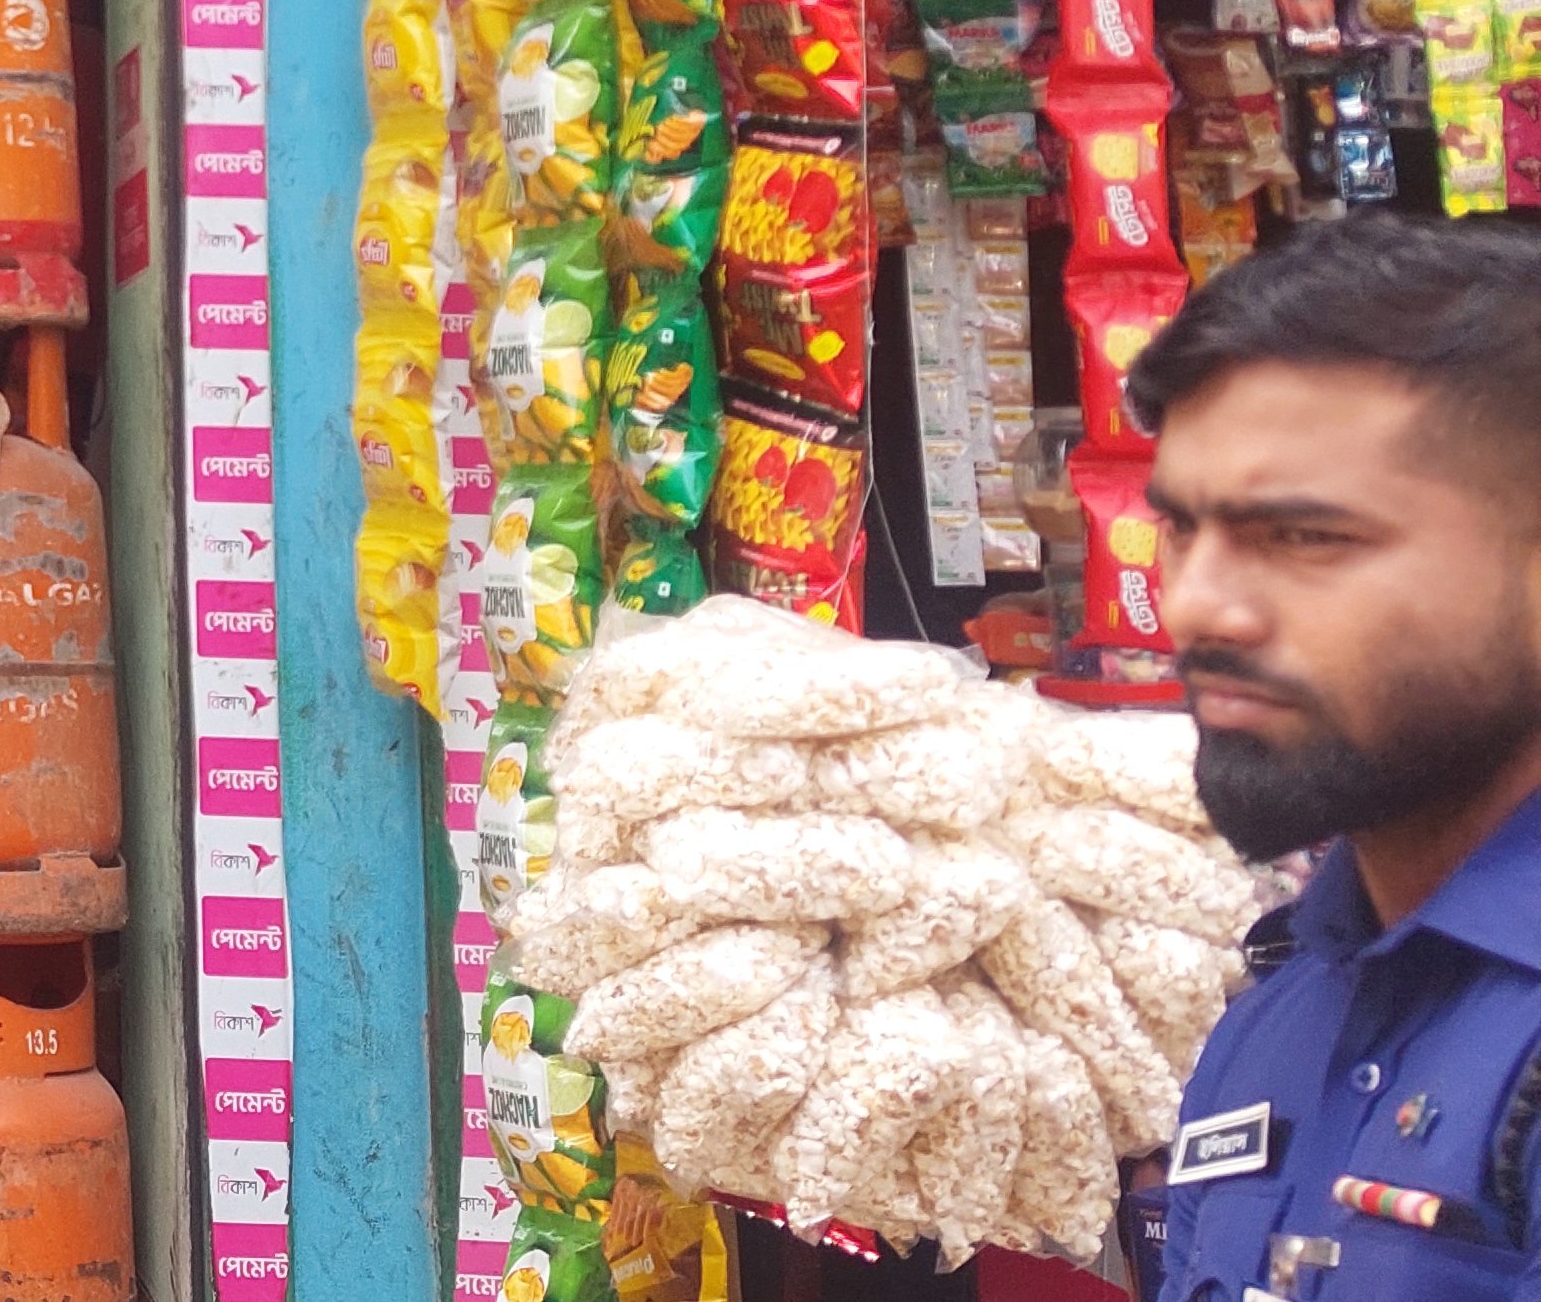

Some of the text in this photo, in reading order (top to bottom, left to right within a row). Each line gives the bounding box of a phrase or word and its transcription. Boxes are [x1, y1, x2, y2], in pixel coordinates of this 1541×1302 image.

[195, 150, 264, 173] পেমেন্ট
[198, 301, 267, 325] পেমেন্ট
[201, 454, 270, 478] পেমেন্ট
[204, 609, 275, 633] পেমেন্ট
[208, 766, 279, 792] পেমেন্ট
[211, 927, 283, 952] পেমেন্ট
[25, 1028, 59, 1056] 13.5
[215, 1088, 286, 1113] পেমেন্ট
[219, 1254, 290, 1279] পেমেন্ট
